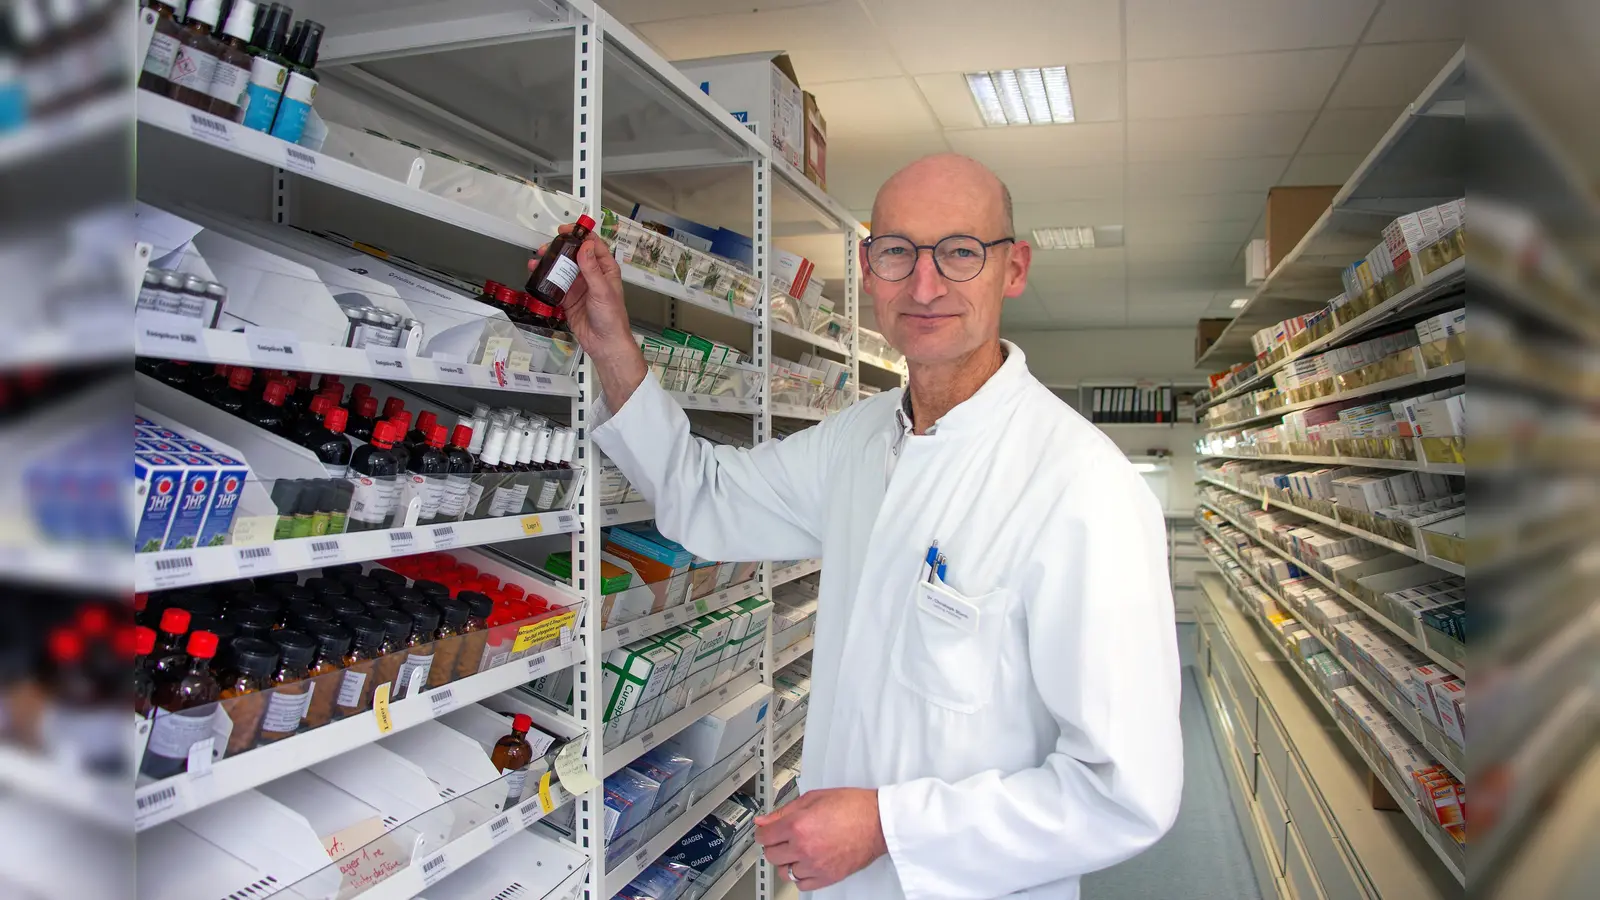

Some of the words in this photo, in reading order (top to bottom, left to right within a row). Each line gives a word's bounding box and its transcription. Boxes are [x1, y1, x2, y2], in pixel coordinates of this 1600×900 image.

[147, 495, 173, 512] JHP
[183, 495, 206, 510] JHP
[215, 494, 238, 509] JHP
[611, 684, 634, 729] Curaspon
[681, 833, 704, 847] QIAGEN
[339, 857, 360, 876] ager
[690, 854, 714, 868] QIAGEN
